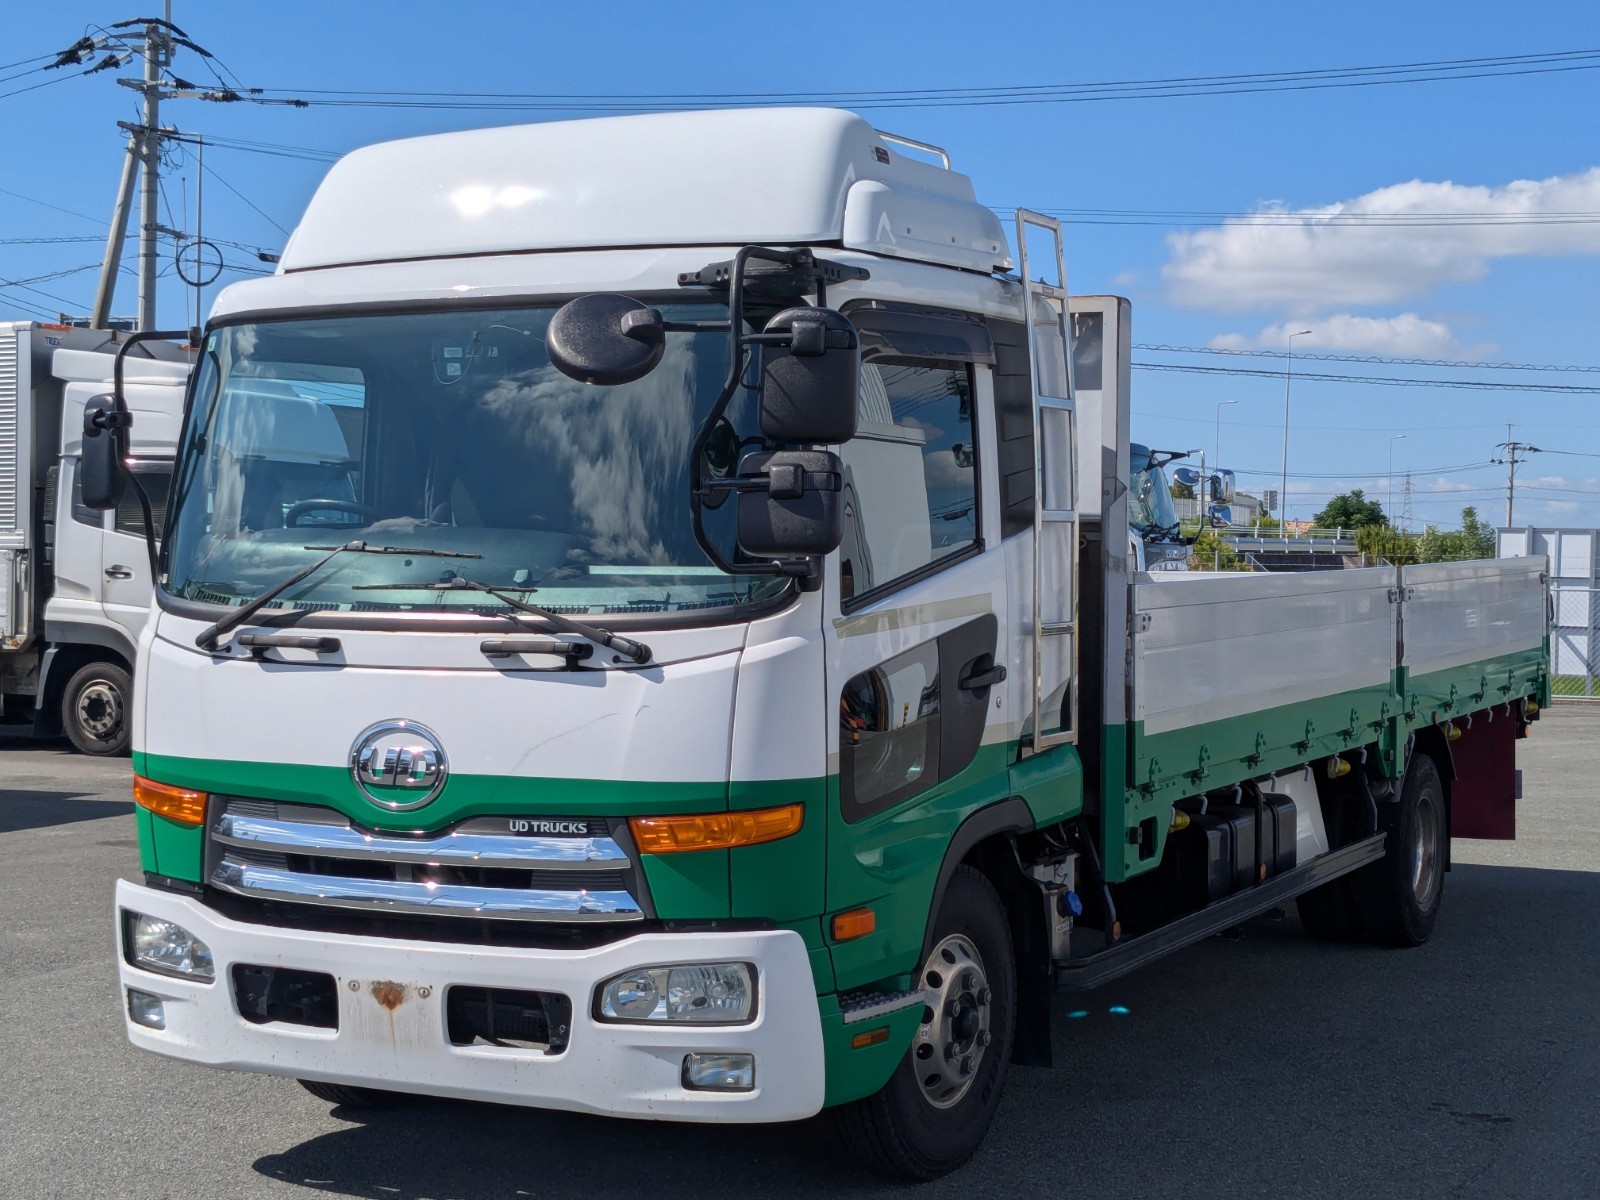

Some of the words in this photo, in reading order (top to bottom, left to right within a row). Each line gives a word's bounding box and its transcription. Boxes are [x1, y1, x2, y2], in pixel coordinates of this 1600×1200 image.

[359, 746, 439, 787] UD
[509, 819, 529, 832] UD
[530, 821, 588, 834] TRUCKS
